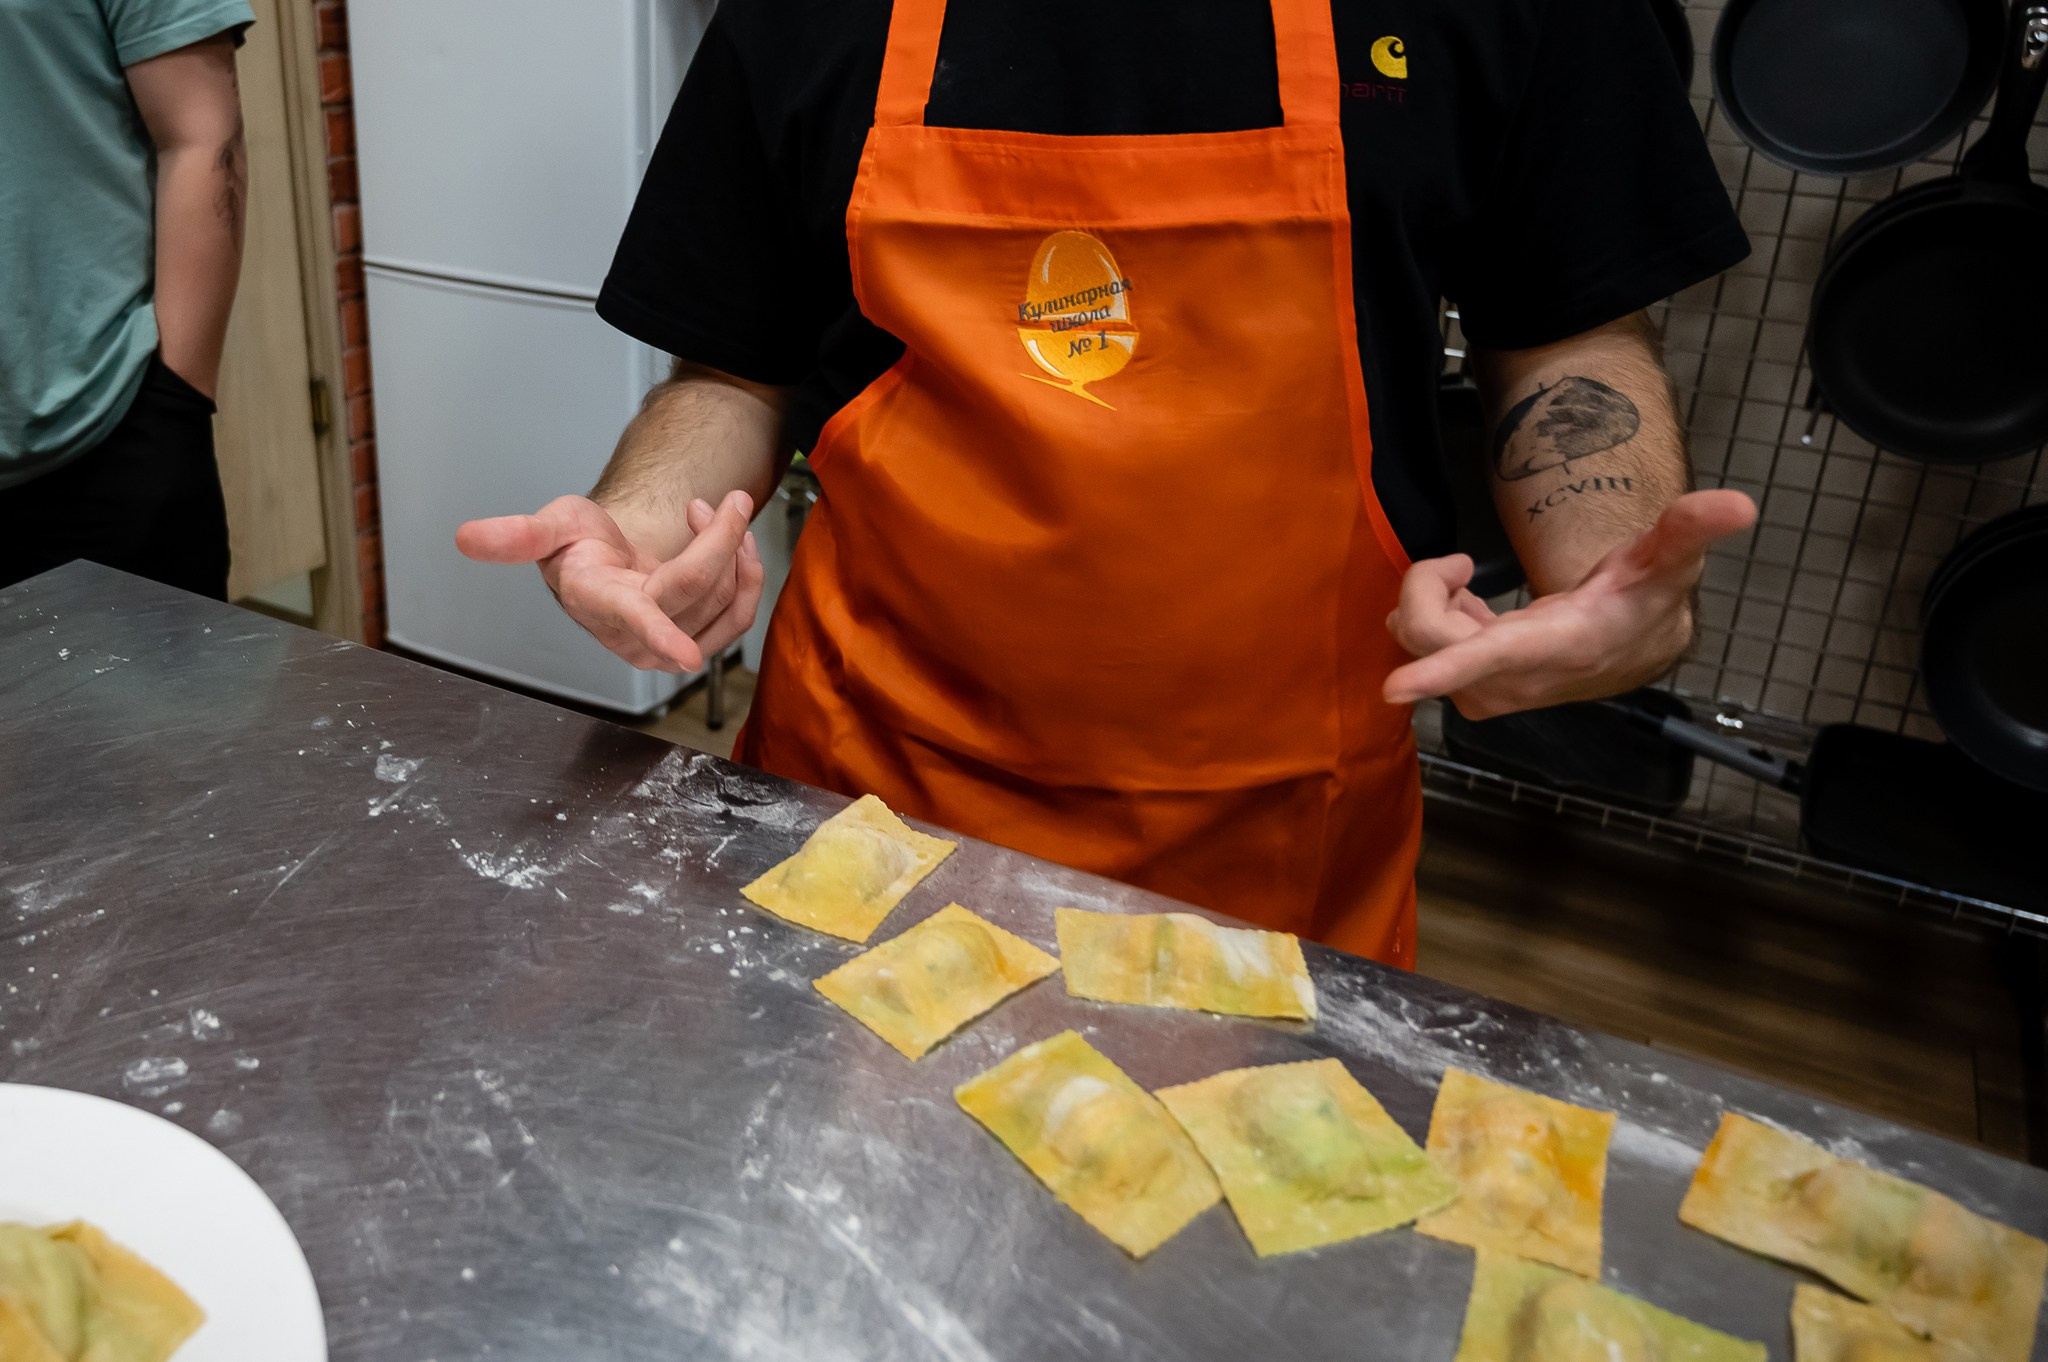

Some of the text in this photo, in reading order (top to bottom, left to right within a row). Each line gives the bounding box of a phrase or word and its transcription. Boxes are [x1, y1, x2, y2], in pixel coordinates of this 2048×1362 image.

[1018, 277, 1133, 322] Кулинарная
[1049, 305, 1111, 333] школа
[1527, 477, 1633, 523] XCVIII
